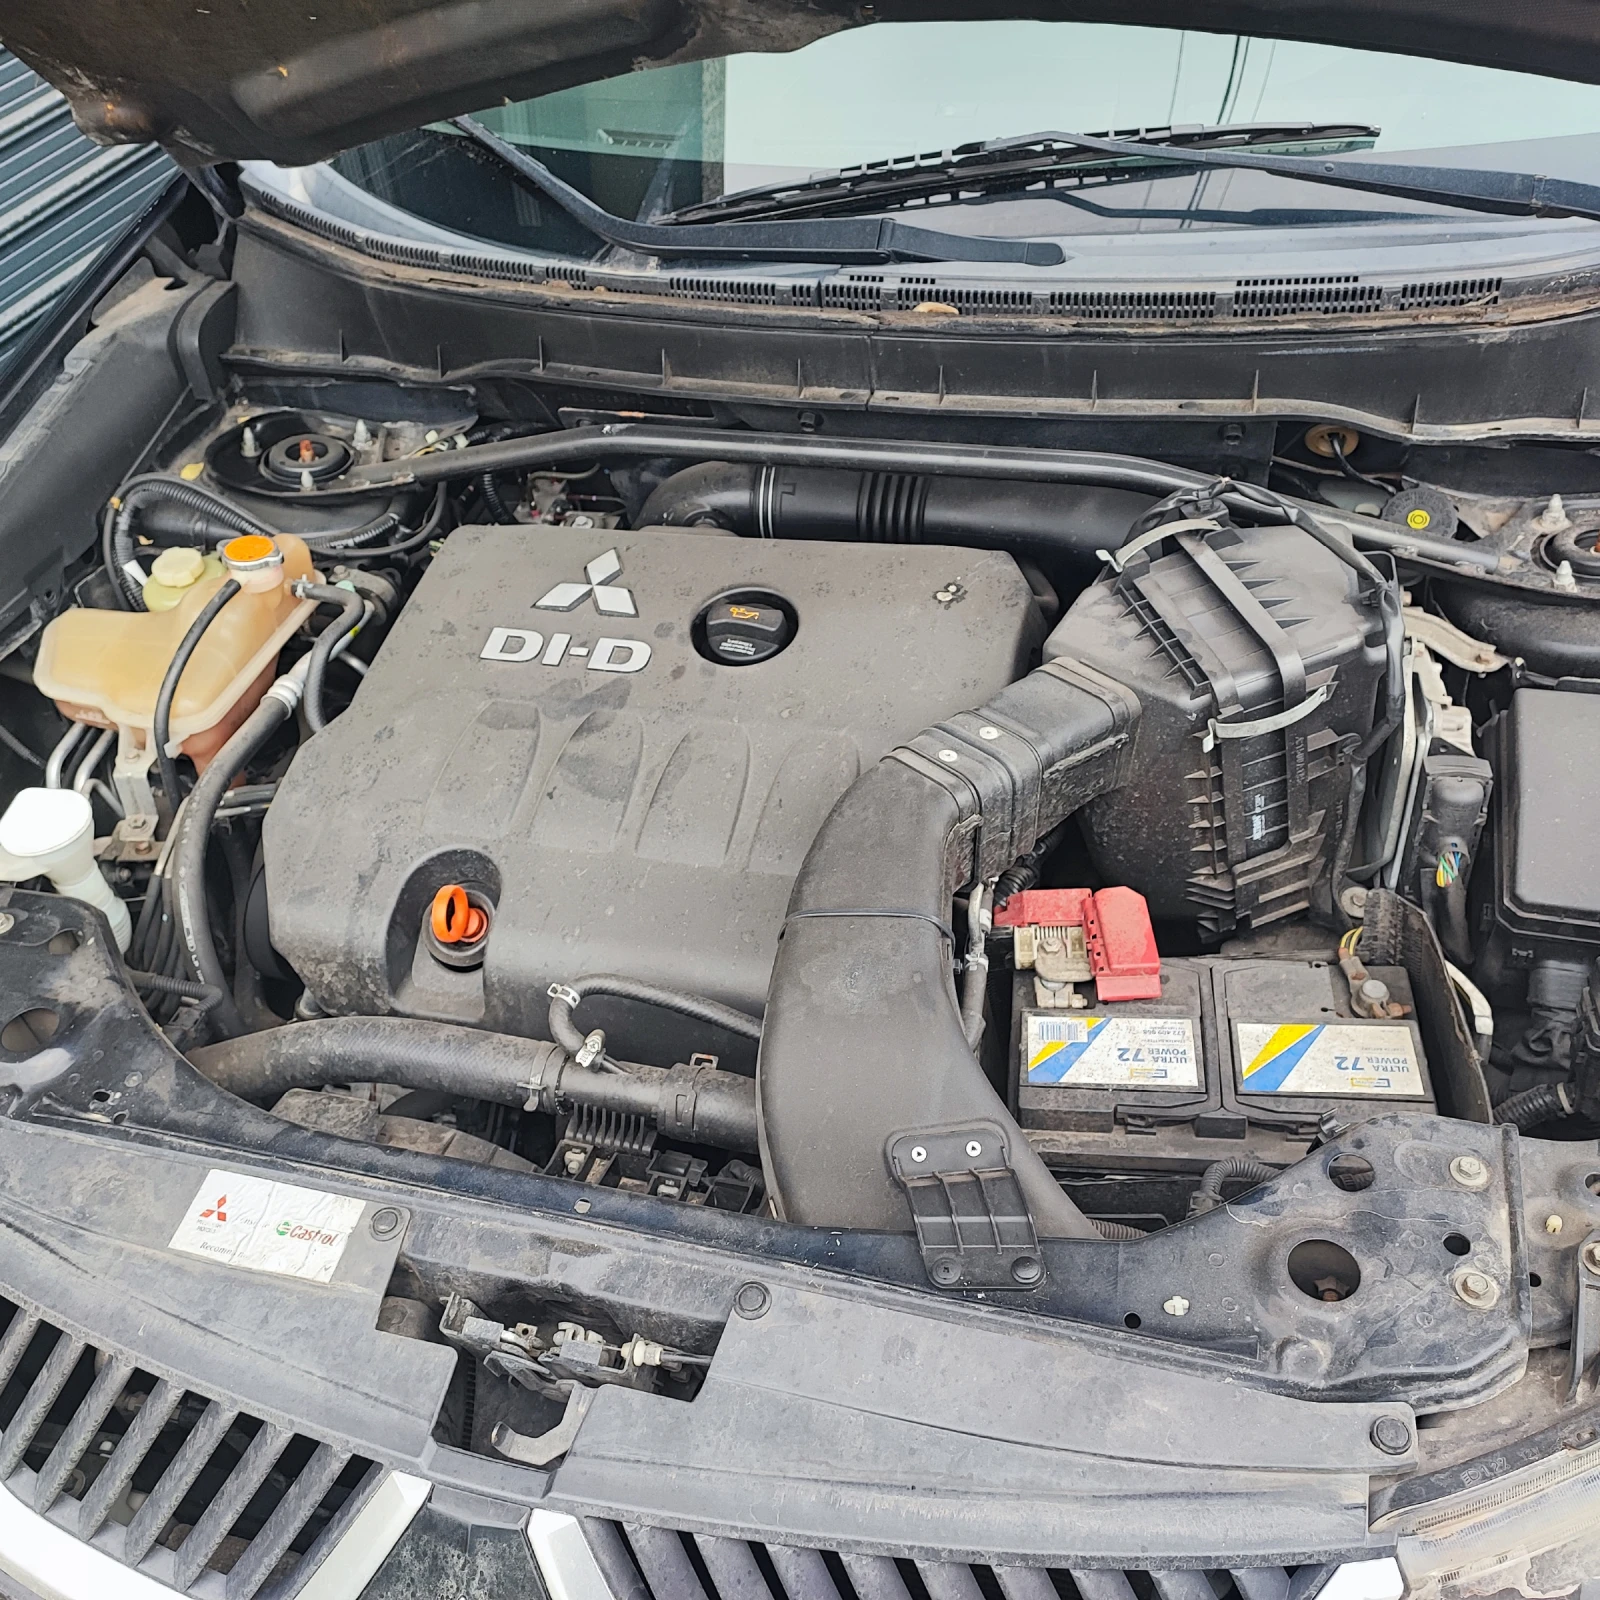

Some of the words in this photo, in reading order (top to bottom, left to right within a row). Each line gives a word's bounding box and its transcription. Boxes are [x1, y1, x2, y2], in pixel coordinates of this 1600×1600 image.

[480, 626, 652, 673] DI-D
[1117, 1047, 1145, 1063] 72
[1147, 1048, 1187, 1056] POWER
[1152, 1056, 1187, 1064] ULTRA
[1334, 1056, 1365, 1071] 72
[1366, 1056, 1408, 1065] POWER
[1372, 1064, 1410, 1073] ULTRA
[290, 1225, 339, 1247] Castrol
